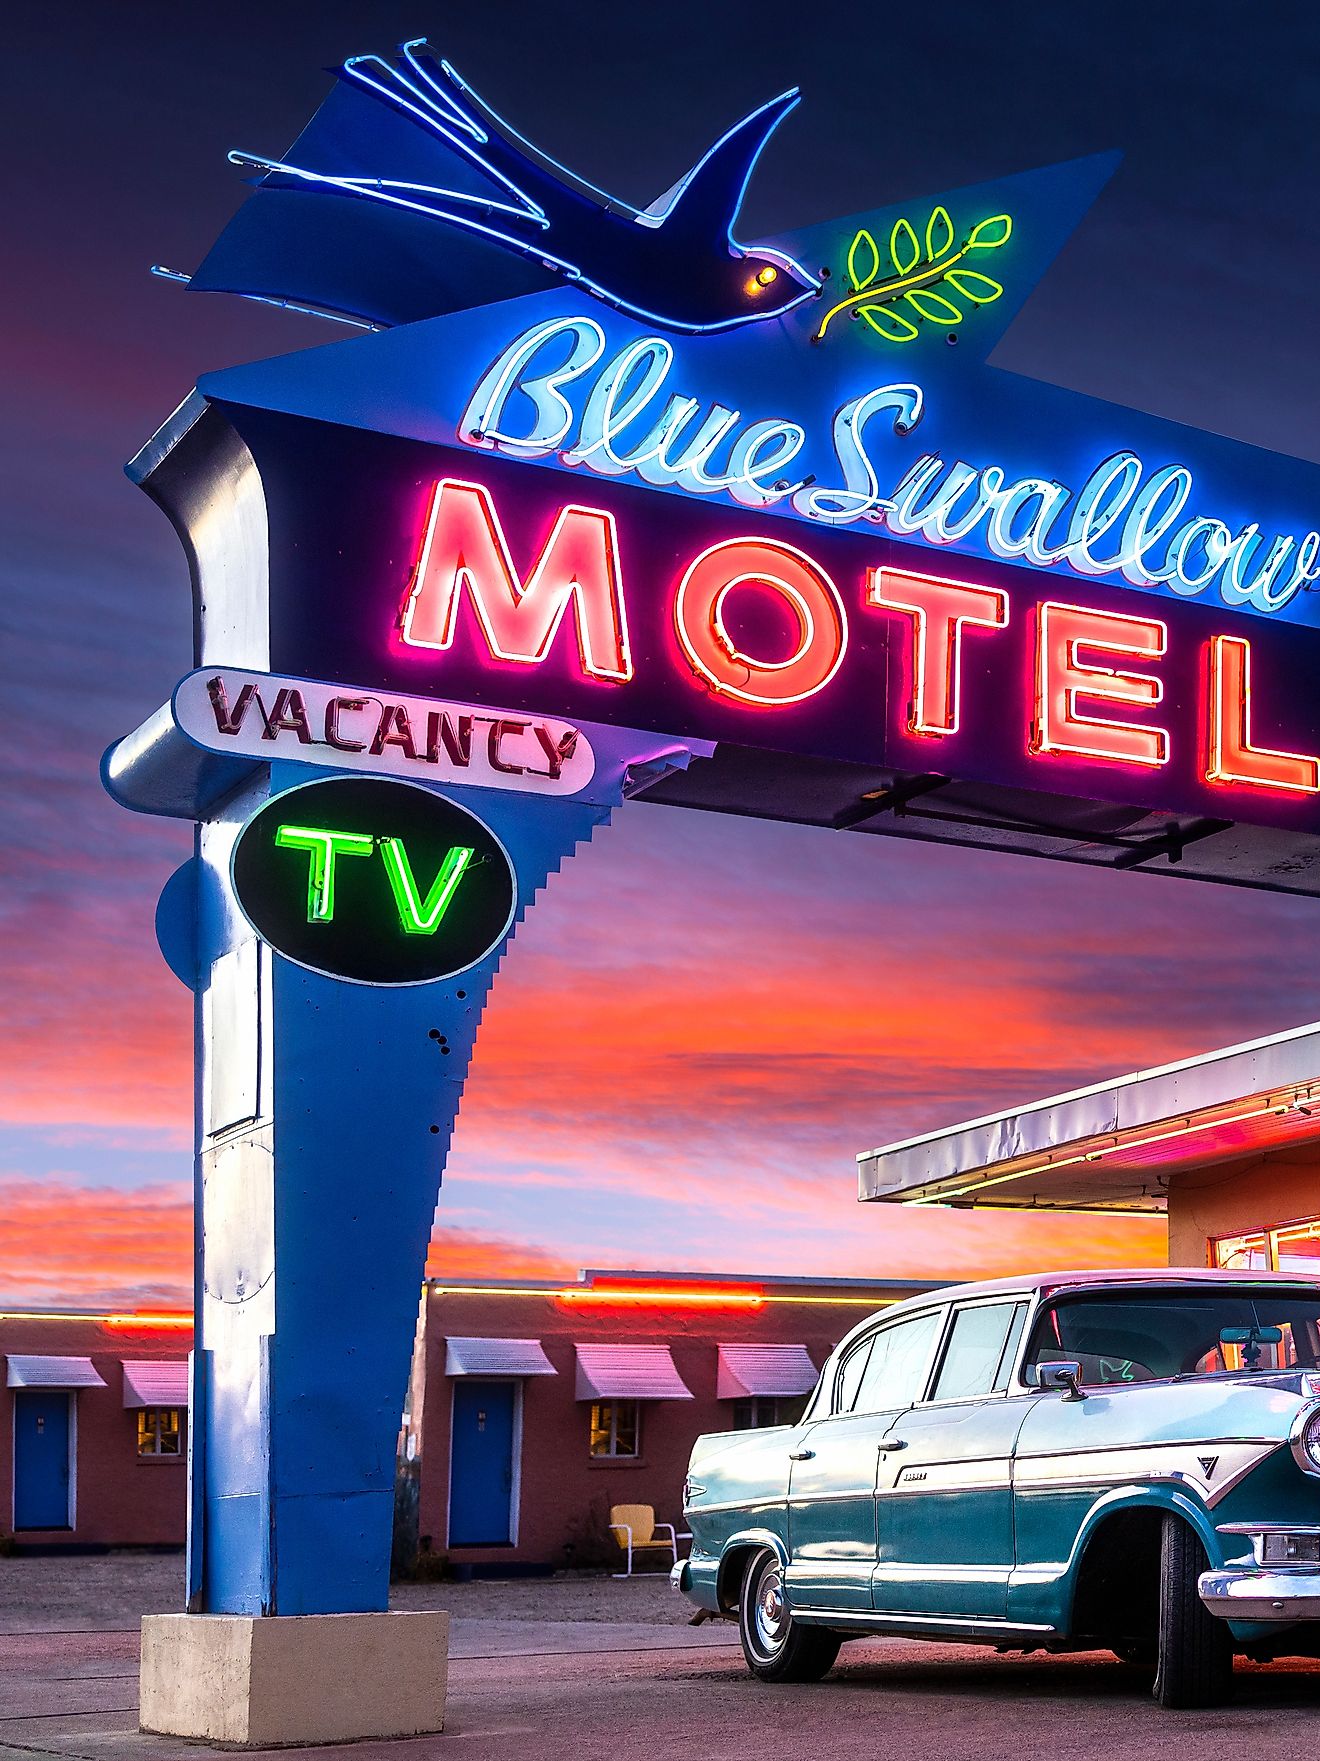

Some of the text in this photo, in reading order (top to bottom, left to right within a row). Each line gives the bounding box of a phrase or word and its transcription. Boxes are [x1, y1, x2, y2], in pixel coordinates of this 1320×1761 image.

[459, 316, 1320, 613] Blue Swallow
[208, 676, 580, 780] VACANCY
[275, 825, 475, 935] TV
